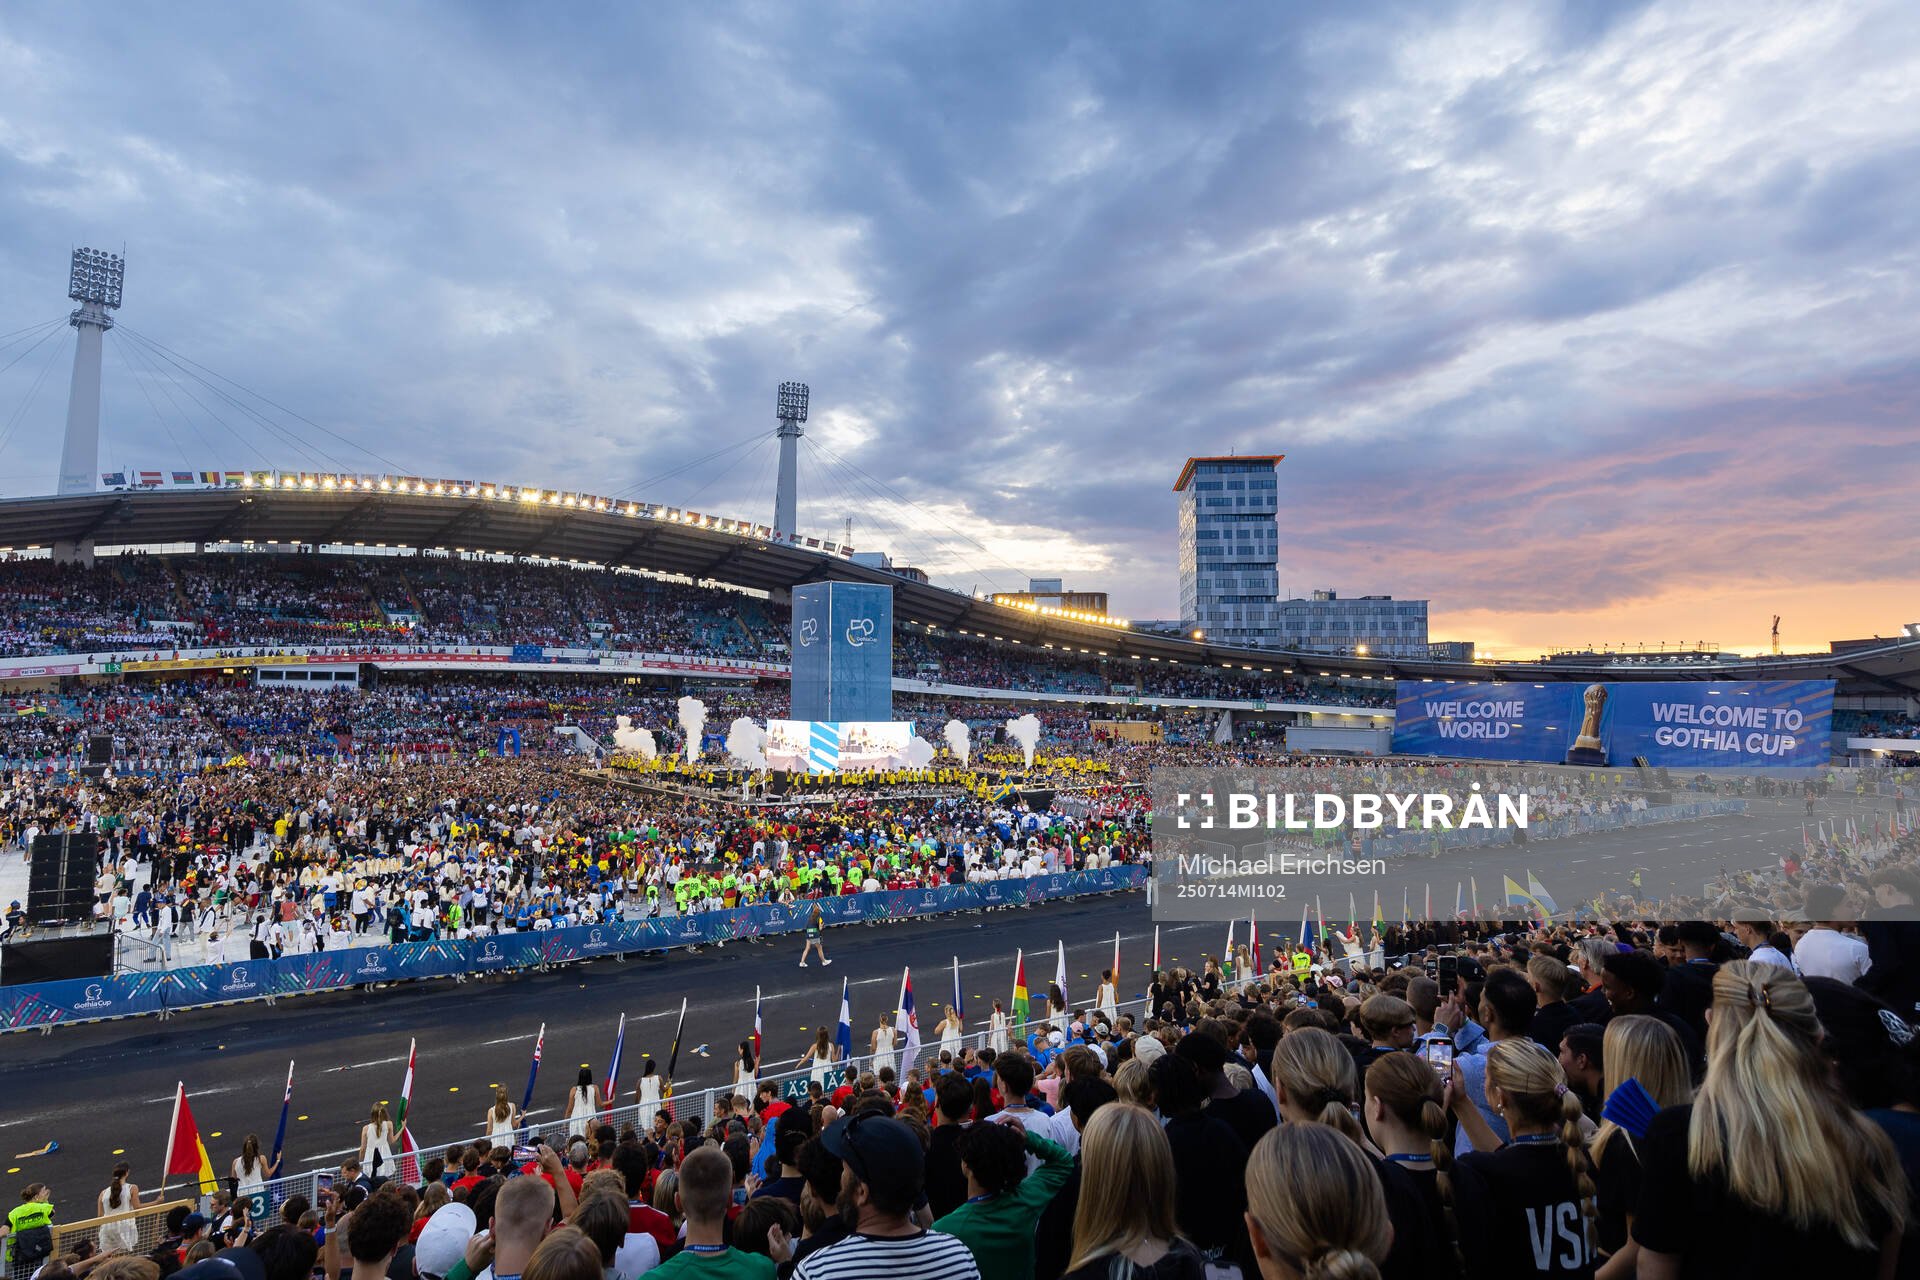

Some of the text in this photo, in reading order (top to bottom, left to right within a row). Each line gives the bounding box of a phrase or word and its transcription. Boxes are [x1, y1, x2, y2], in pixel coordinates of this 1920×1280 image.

[1425, 701, 1525, 719] WELCOME
[1652, 702, 1803, 731] WELCOME TO
[1437, 721, 1510, 739] WORLD
[1655, 726, 1796, 756] GOTHIA CUP
[787, 1080, 808, 1097] Ä3
[826, 1071, 847, 1090] Ä2
